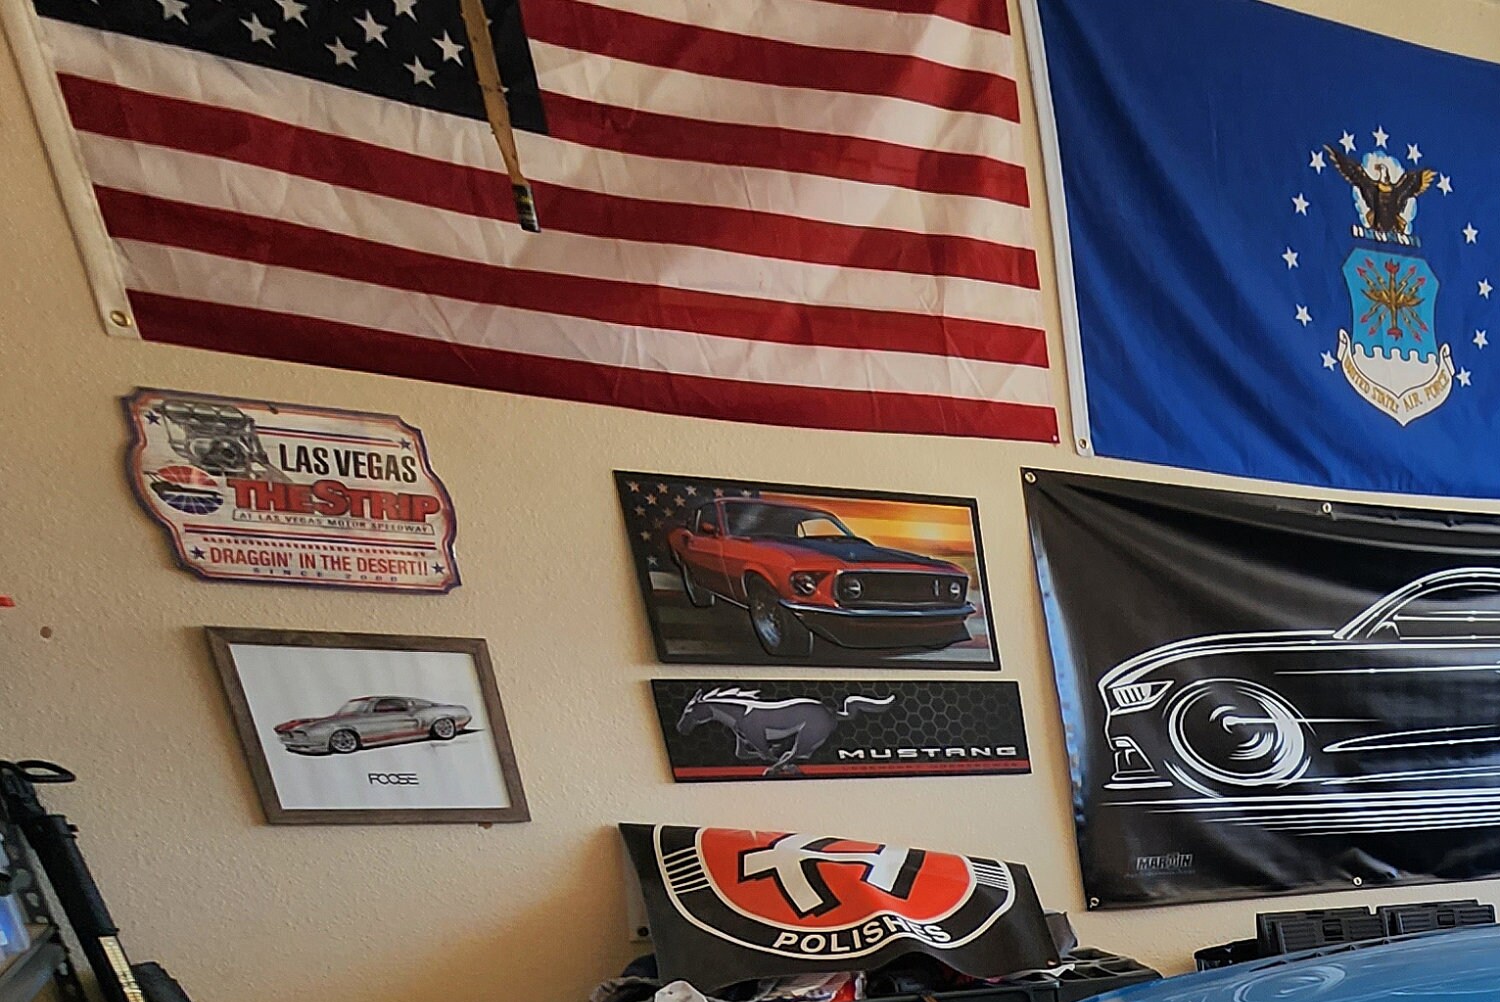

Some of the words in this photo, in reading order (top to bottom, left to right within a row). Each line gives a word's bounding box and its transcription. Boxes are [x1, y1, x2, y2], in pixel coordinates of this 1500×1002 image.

[1403, 392, 1423, 412] AIR
[1424, 369, 1450, 400] FORCE
[279, 443, 330, 476] LAS
[333, 449, 418, 483] VEGAS
[239, 512, 253, 521] AT
[258, 514, 284, 524] LAS
[286, 516, 323, 526] VEGAS
[327, 518, 367, 529] MOTOR
[371, 521, 429, 533] SPEEDWAY
[210, 547, 293, 568] DRAGGIN'
[299, 553, 317, 569] IN
[320, 554, 352, 572] THE
[357, 558, 428, 576] DESERT!!
[252, 567, 324, 578] SINCE
[838, 746, 1017, 760] MUSTANG
[368, 773, 419, 785] FOOSE
[772, 915, 951, 953] POLISHES
